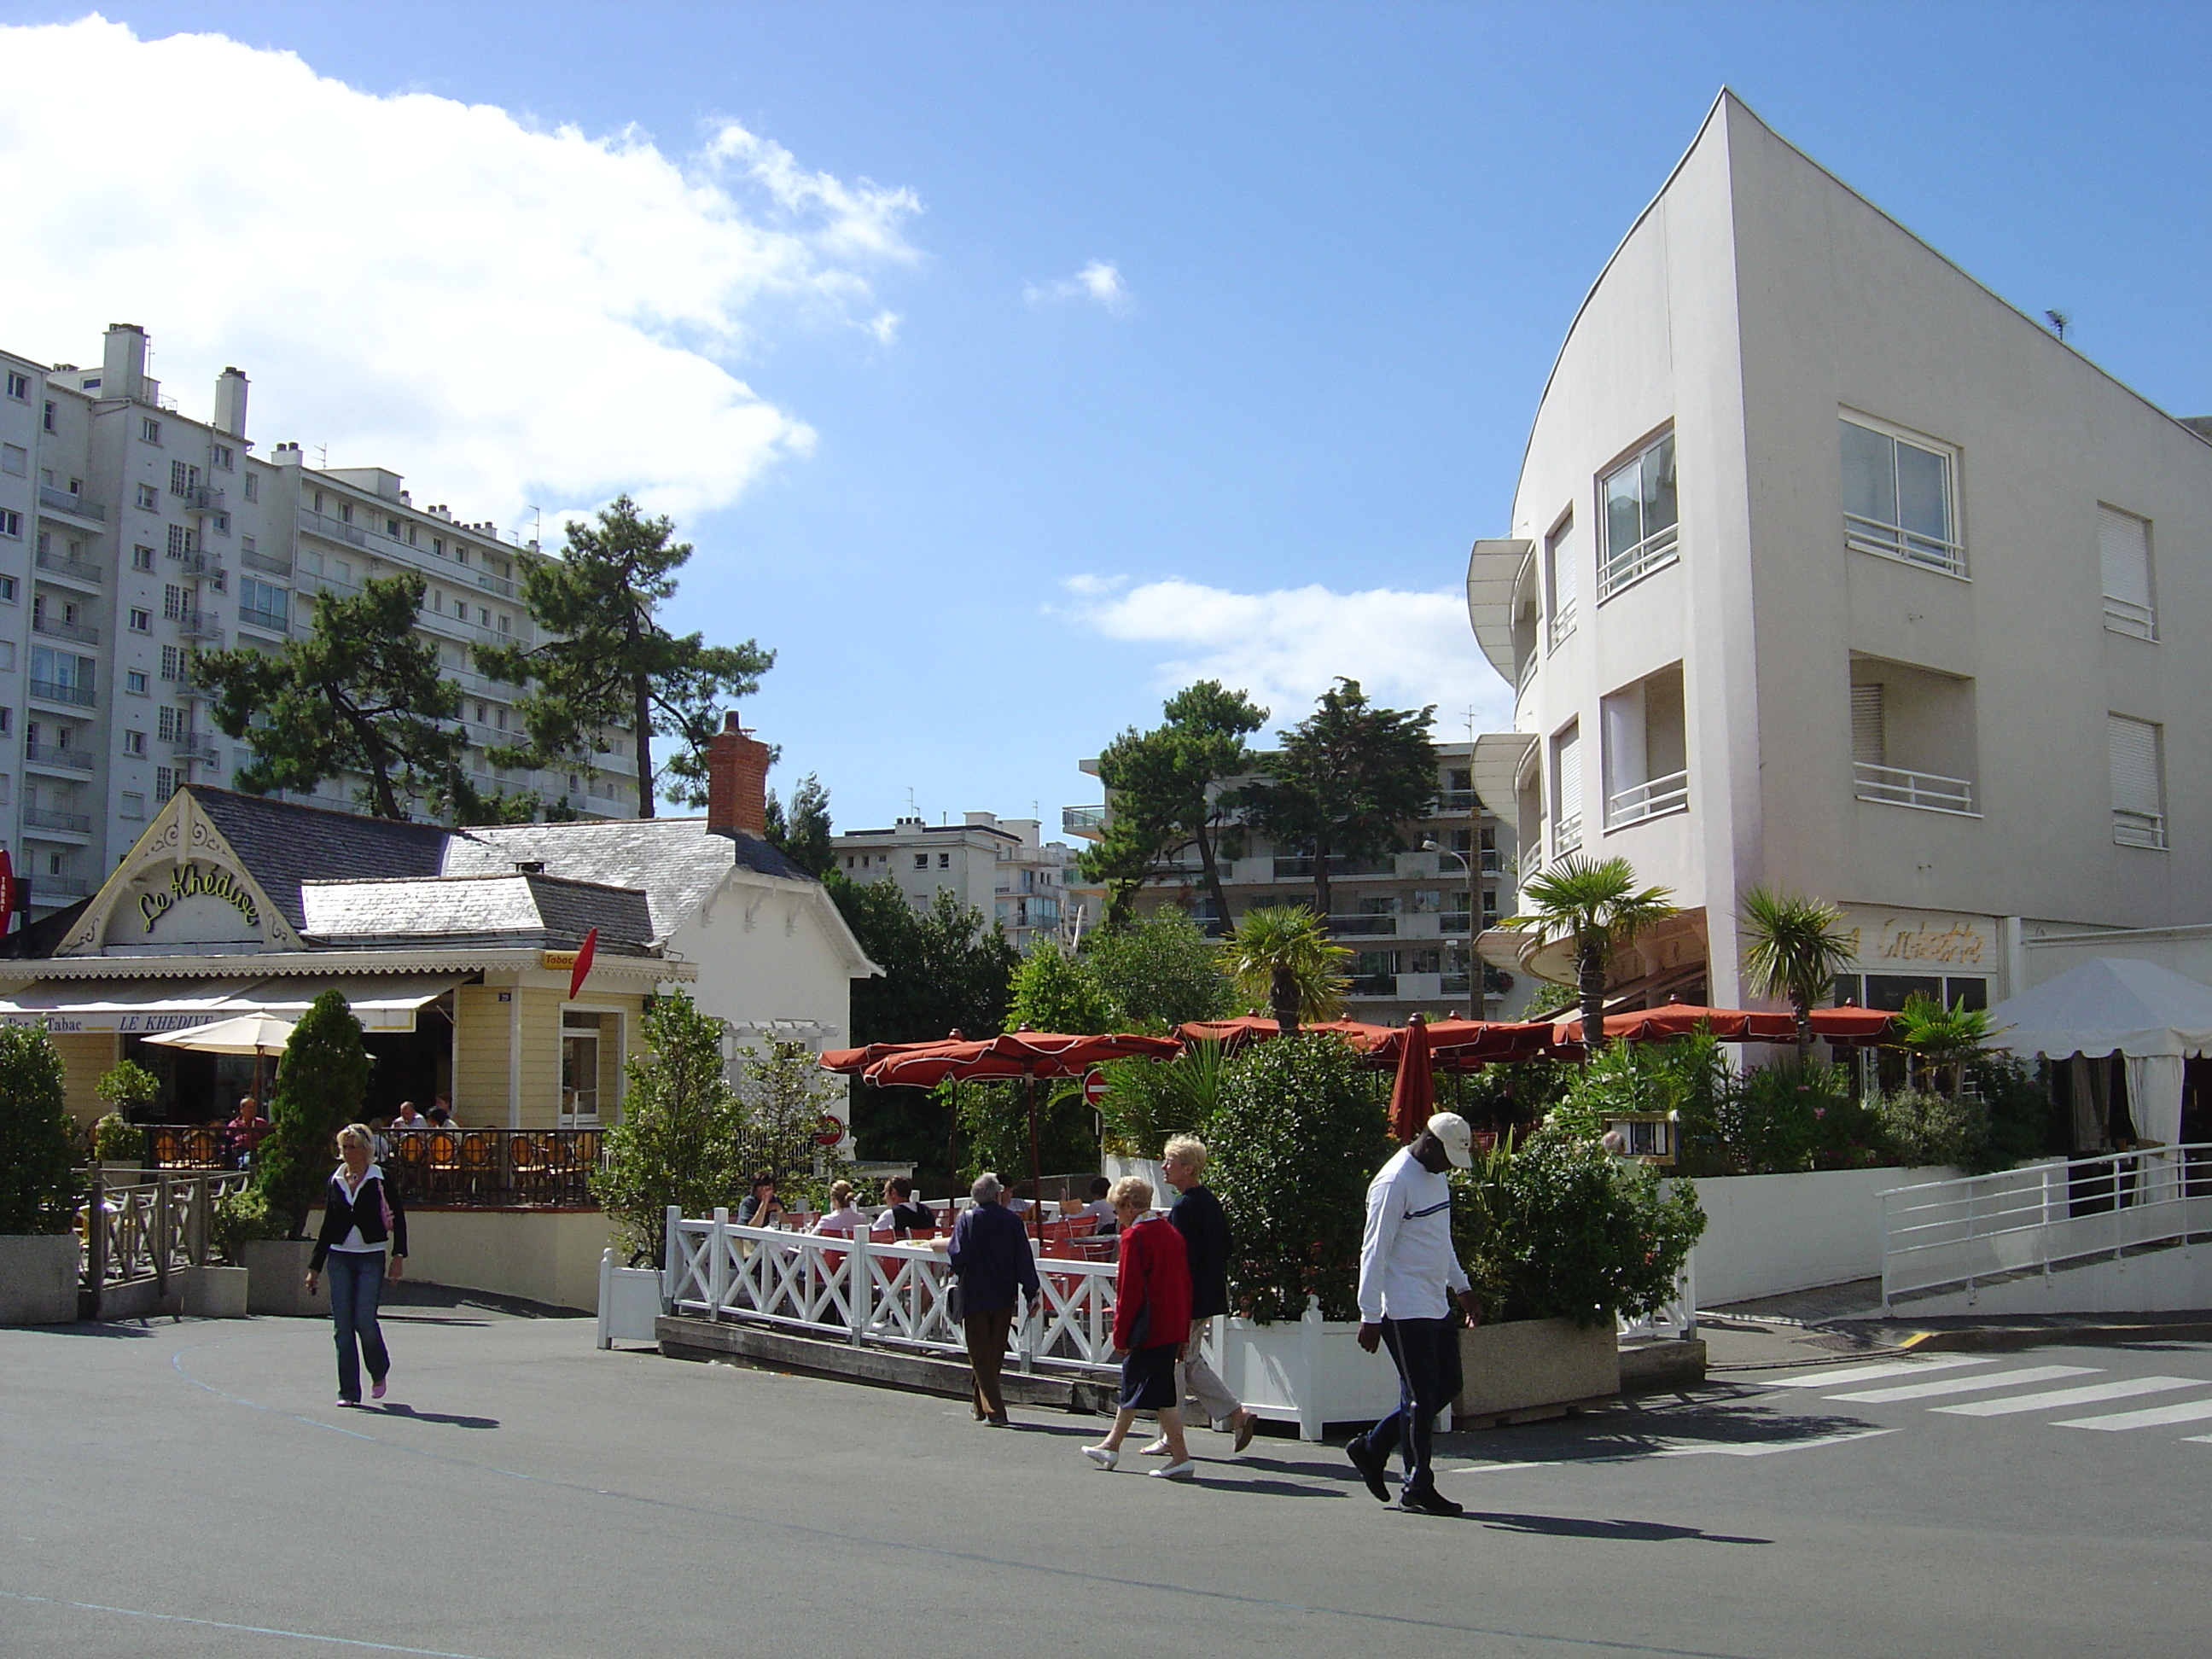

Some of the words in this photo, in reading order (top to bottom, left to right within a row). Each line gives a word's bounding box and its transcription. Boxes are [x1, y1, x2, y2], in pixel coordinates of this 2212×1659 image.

[138, 894, 172, 932] Le
[546, 954, 573, 964] Tabac
[47, 1017, 82, 1031] Tabac
[119, 1016, 140, 1031] LE
